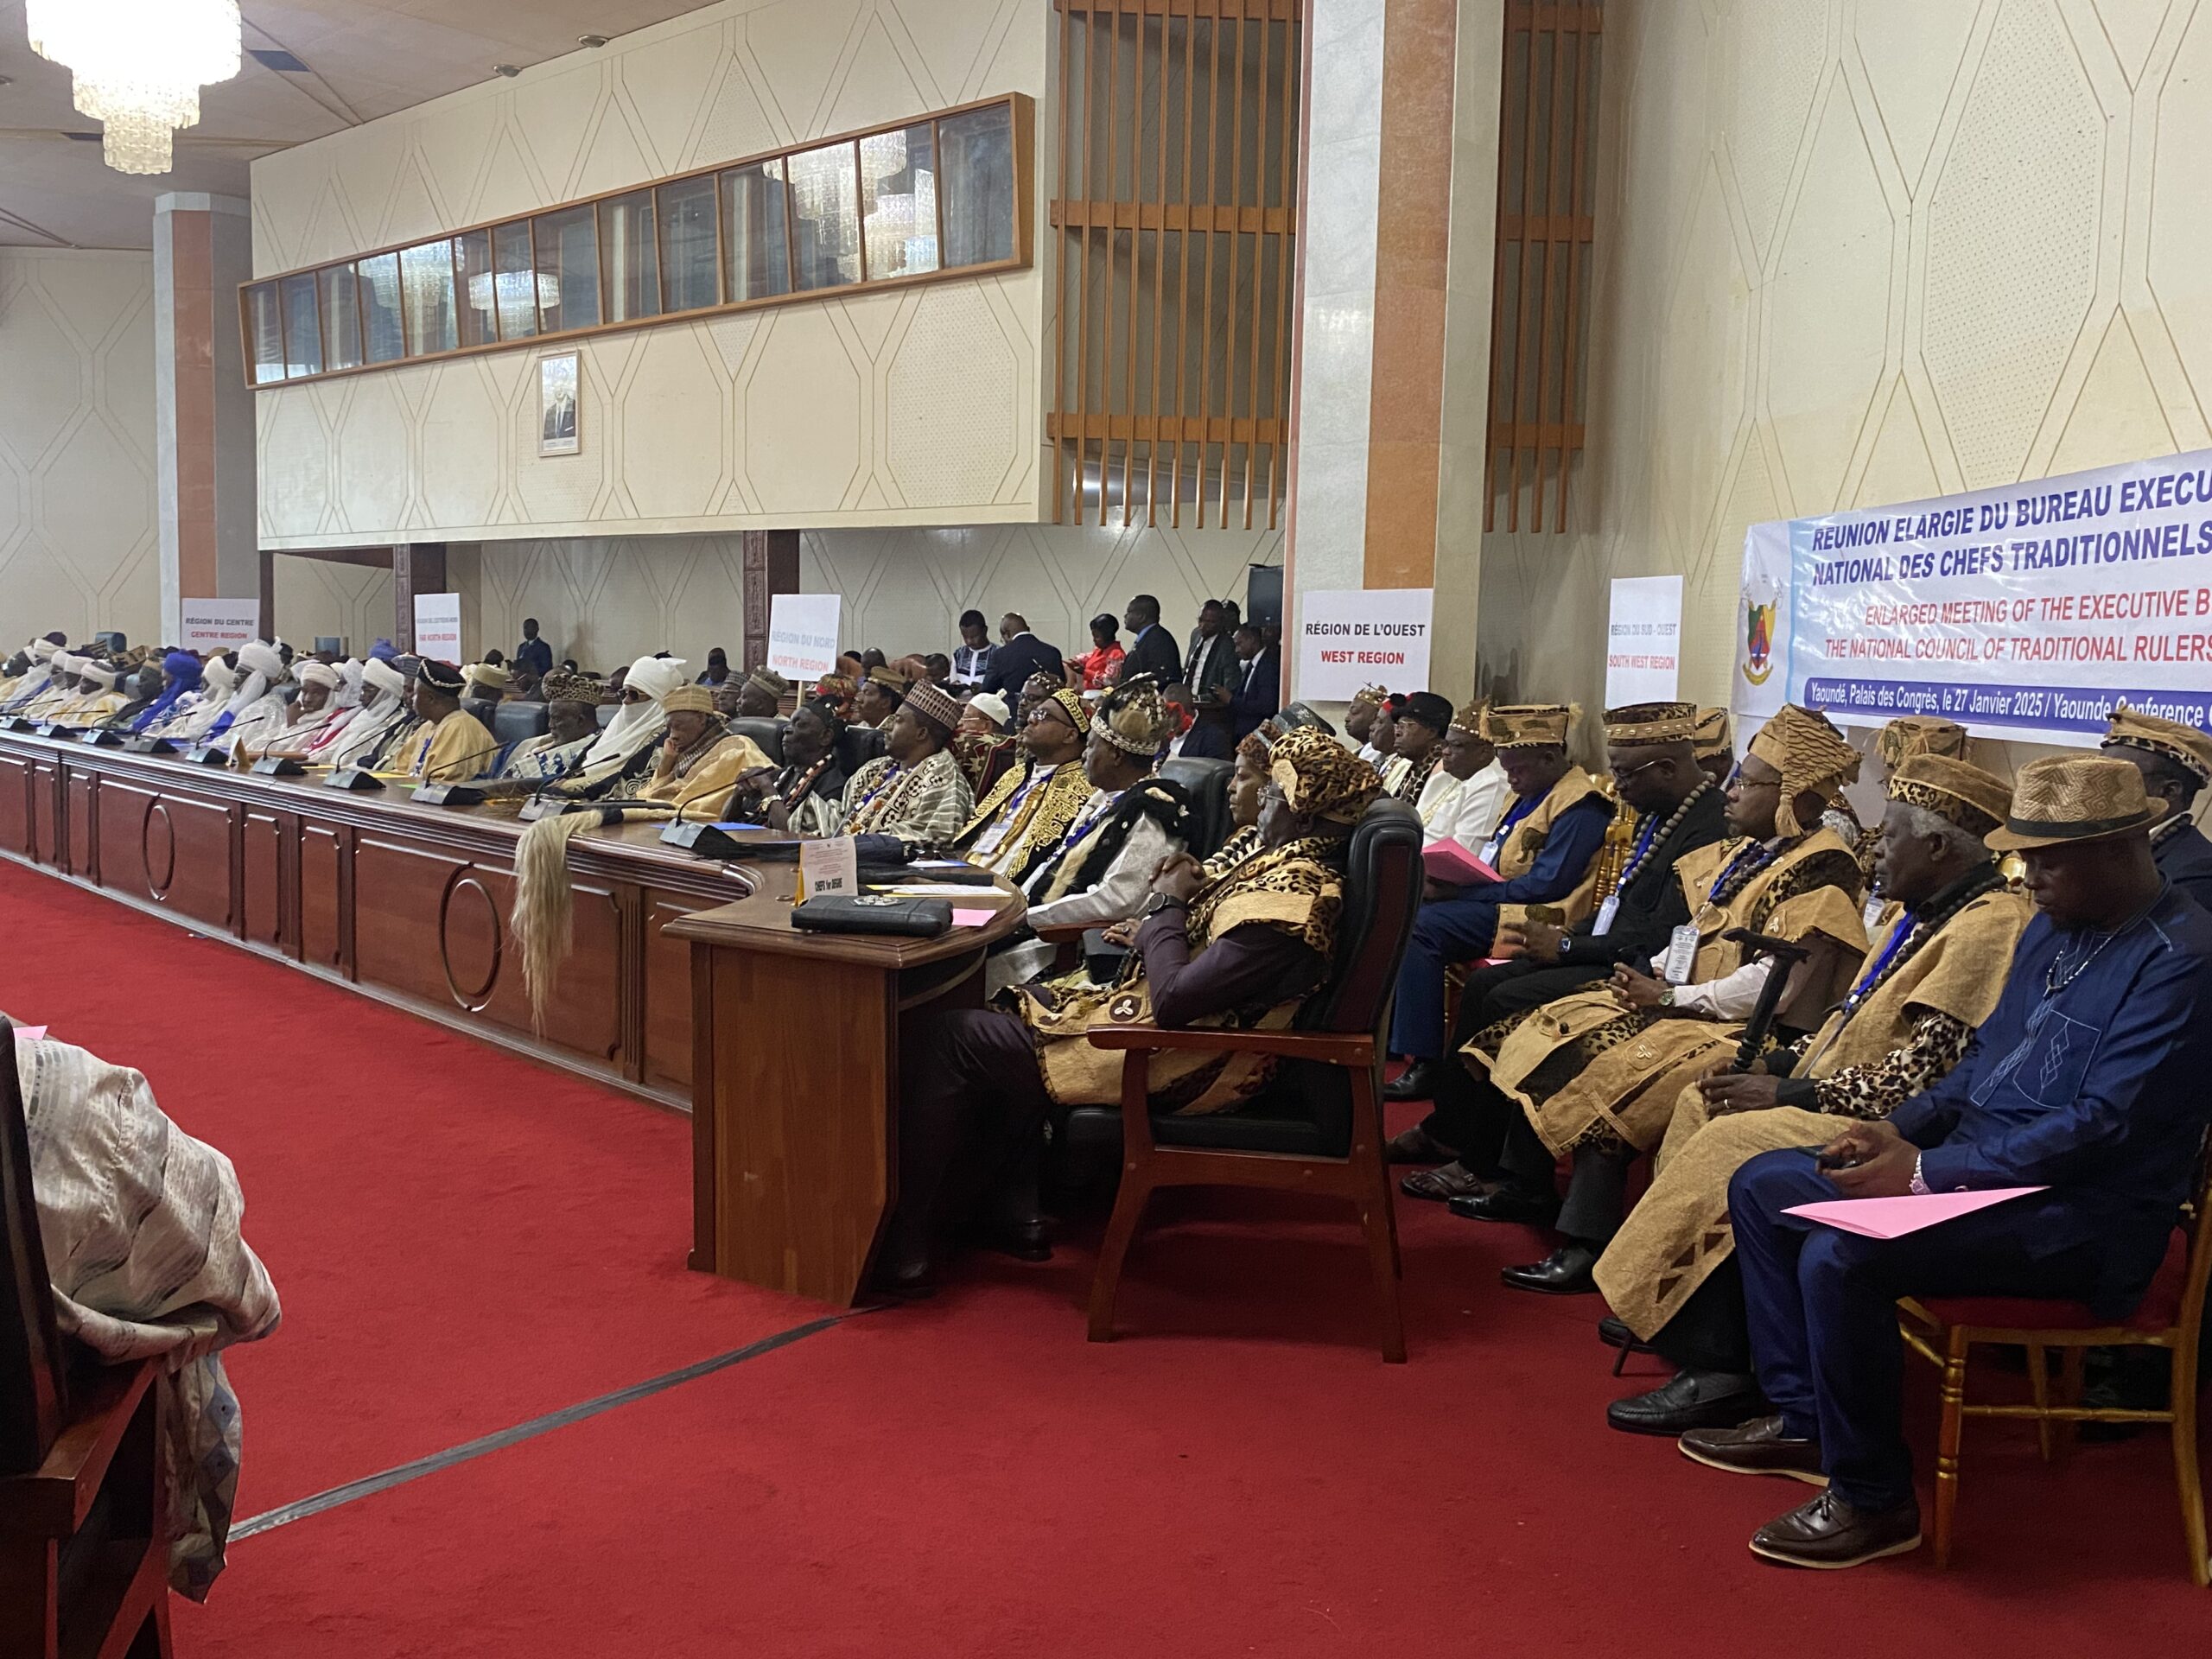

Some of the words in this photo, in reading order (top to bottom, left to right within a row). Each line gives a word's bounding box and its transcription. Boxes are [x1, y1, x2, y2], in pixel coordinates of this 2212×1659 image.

[1894, 507, 1974, 543] ELARGIE
[1980, 501, 2009, 532] DU
[2015, 485, 2112, 527] BUREAU
[1813, 556, 1893, 586] NATIONAL
[1899, 552, 1935, 580] DES
[1940, 544, 2003, 576] CHEFS
[2011, 520, 2212, 571] TRADITIONNELS
[1865, 604, 1937, 626] ENLARGED
[1941, 600, 2007, 624] MEETING
[2012, 599, 2036, 622] OF
[2041, 596, 2075, 621] THE
[2078, 589, 2189, 620] EXECUTIVE
[1306, 620, 1351, 636] RÉGION
[1354, 623, 1370, 636] DE
[1374, 623, 1426, 637] L'OUEST
[1657, 623, 1677, 636] OUEST
[801, 633, 812, 646] DU
[813, 635, 836, 649] NORD
[1825, 639, 1847, 658] THE
[1849, 639, 1911, 658] NATIONAL
[1915, 638, 1979, 660] COUNCIL
[1983, 638, 2006, 660] OF
[2011, 636, 2127, 661] TRADITIONAL
[772, 655, 798, 667] NORTH
[800, 658, 829, 671] REGION
[1321, 650, 1354, 663] WEST
[1357, 652, 1404, 664] REGION
[1609, 654, 1630, 668] SOUTH
[1630, 655, 1649, 669] WEST
[1649, 656, 1675, 670] REGION
[1811, 682, 1848, 707] Yaoundé,
[1849, 684, 1876, 705] Palais
[1877, 685, 1894, 707] des
[1942, 688, 1952, 711] le
[1954, 689, 1968, 712] 27
[1969, 690, 2012, 715] Janvier
[2012, 691, 2043, 716] 2025
[2044, 692, 2051, 717] /
[2054, 693, 2111, 721] Yaounde
